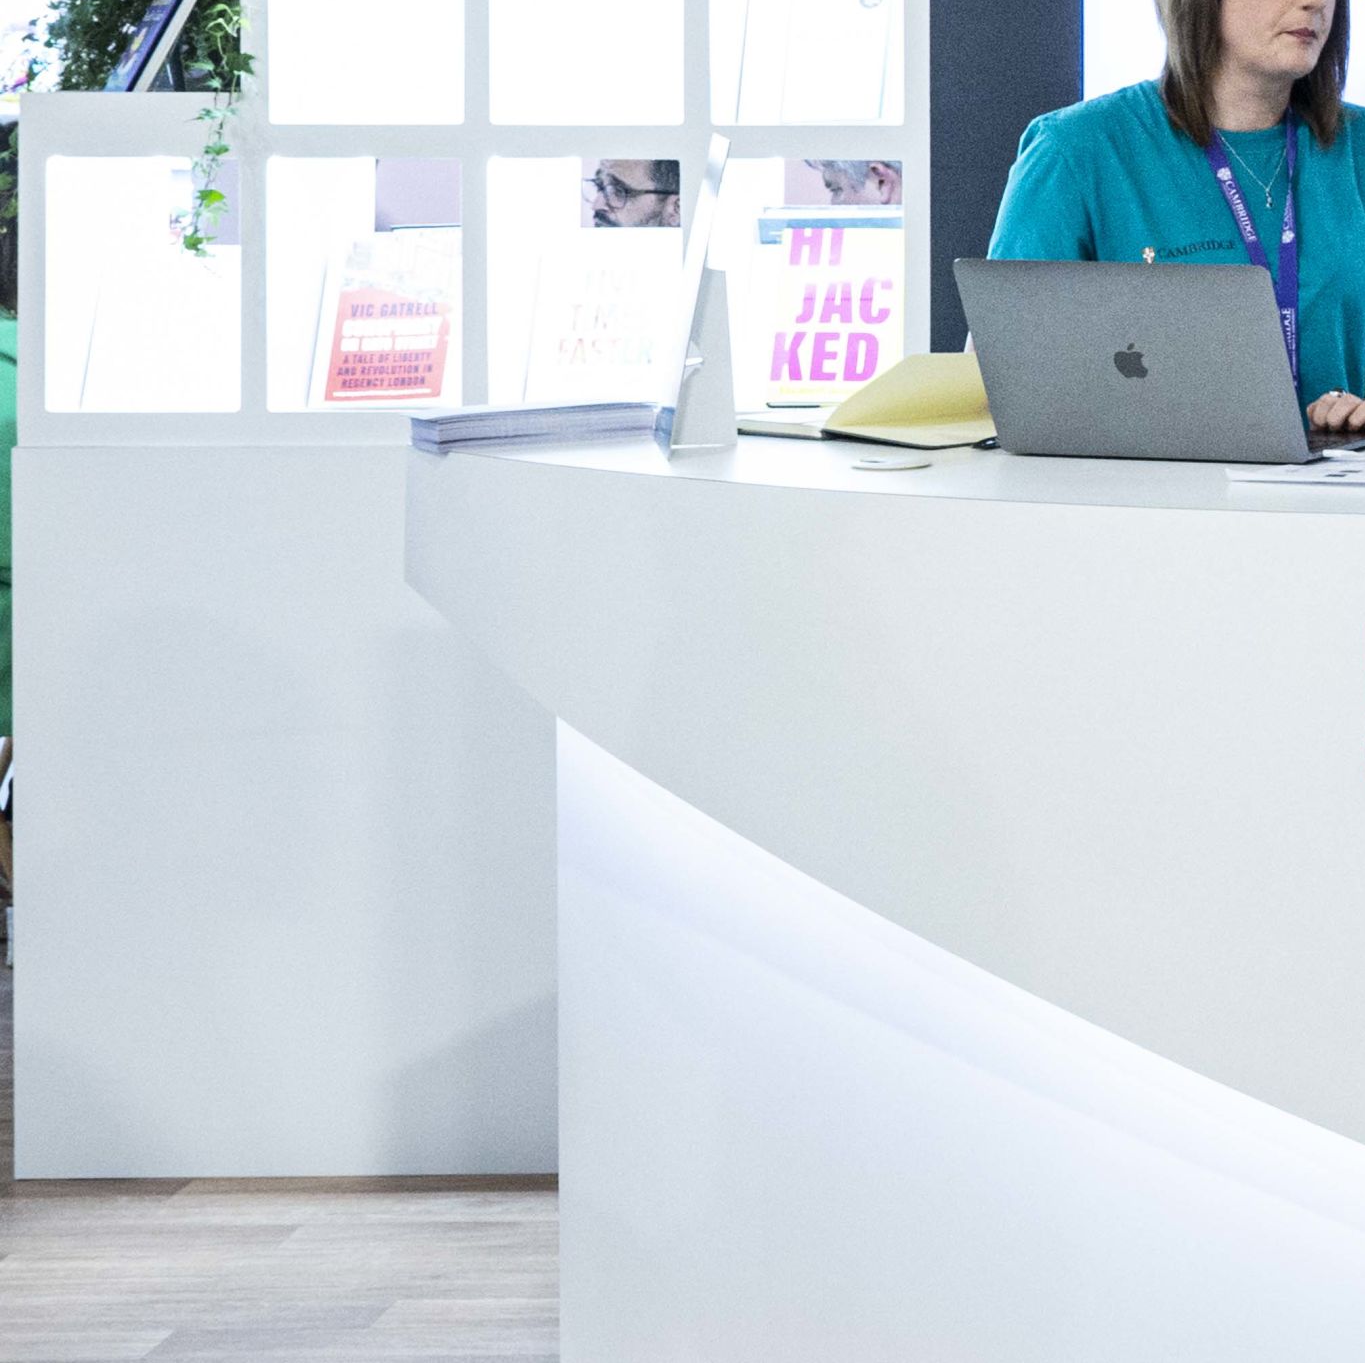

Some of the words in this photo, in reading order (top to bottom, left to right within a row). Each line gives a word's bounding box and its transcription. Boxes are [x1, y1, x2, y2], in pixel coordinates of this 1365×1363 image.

[1225, 180, 1257, 241] CAMBRIDGE
[789, 228, 845, 266] HI
[1157, 239, 1235, 259] CAMBRIDGE
[351, 304, 375, 318] VIC
[380, 302, 439, 317] GATRELL
[795, 277, 893, 325] JAC
[353, 353, 374, 364] TALE
[378, 353, 390, 363] OF
[393, 352, 432, 362] LIBERTY
[770, 331, 880, 382] KED
[336, 366, 357, 376] AND
[360, 364, 419, 376] REVOLUTION
[424, 364, 433, 374] IN
[341, 376, 384, 389] REGENCY
[388, 375, 426, 388] LONDON
